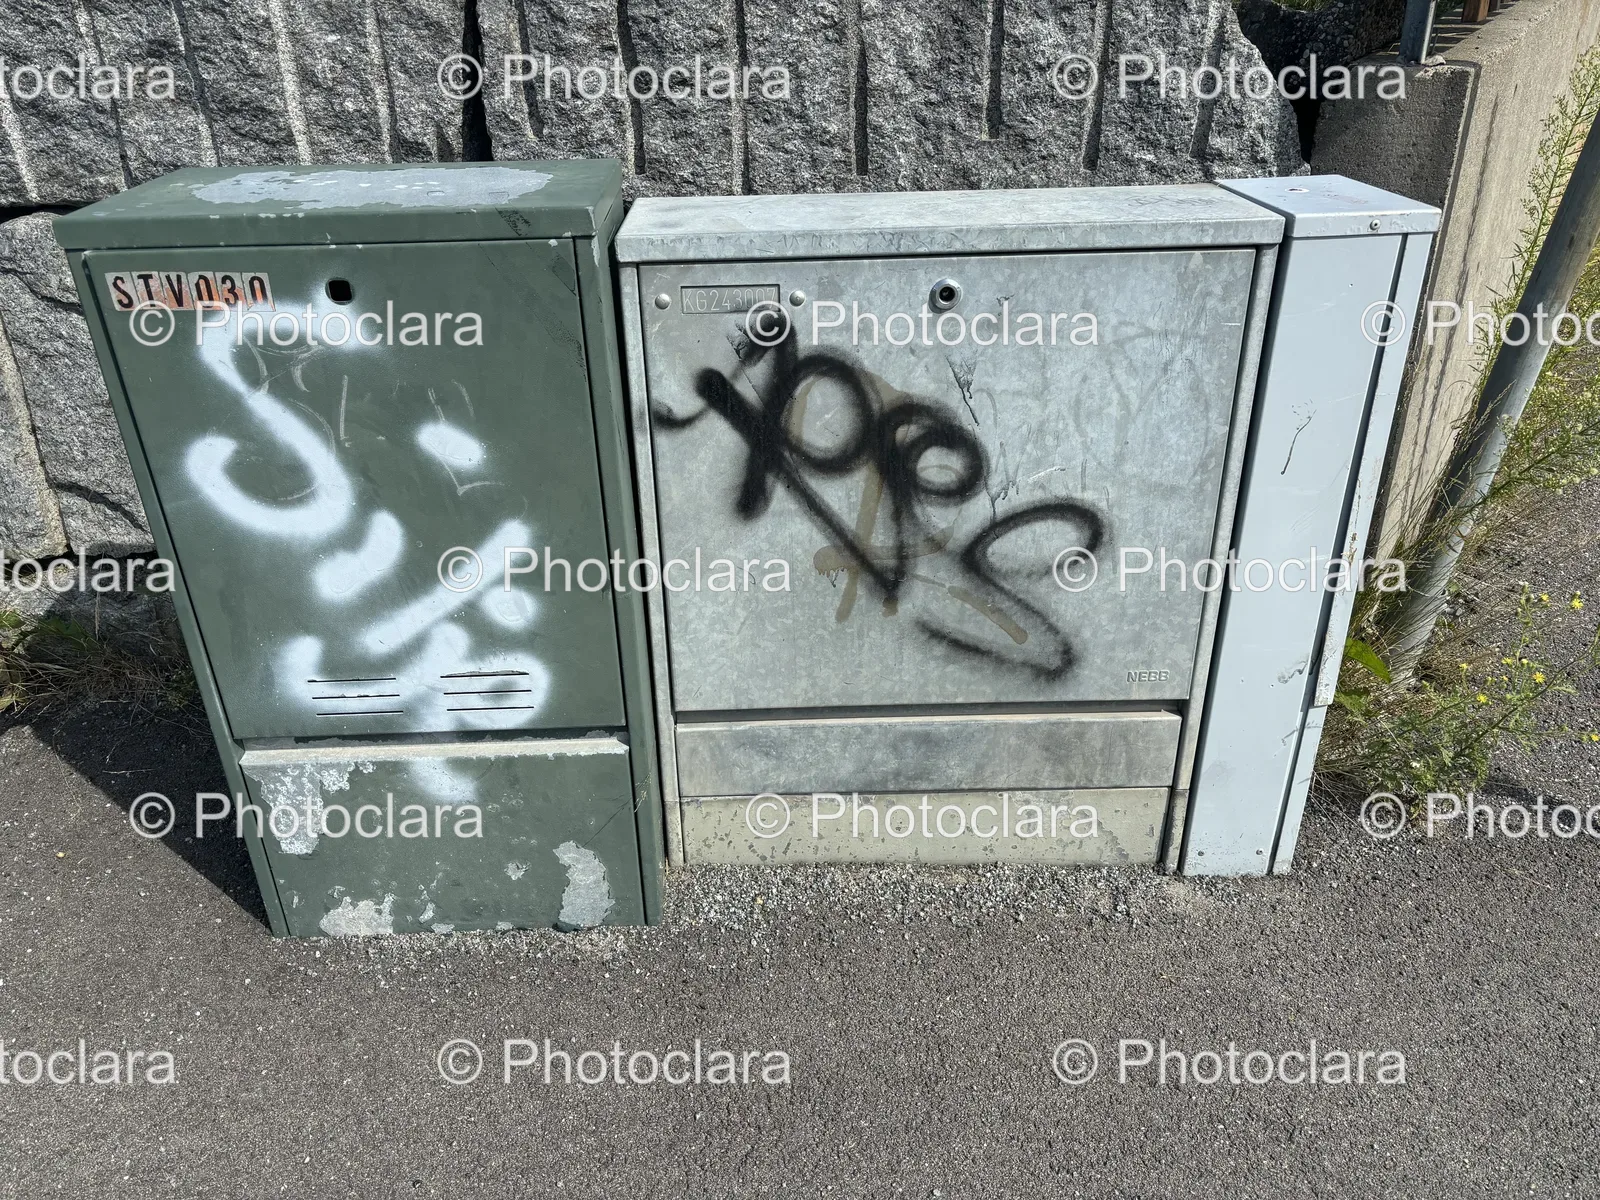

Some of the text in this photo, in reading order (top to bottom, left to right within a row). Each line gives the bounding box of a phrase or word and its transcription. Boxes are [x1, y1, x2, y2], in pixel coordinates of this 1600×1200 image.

[111, 273, 269, 309] STV030
[682, 287, 777, 312] KG243007
[1126, 669, 1170, 683] NEBB
